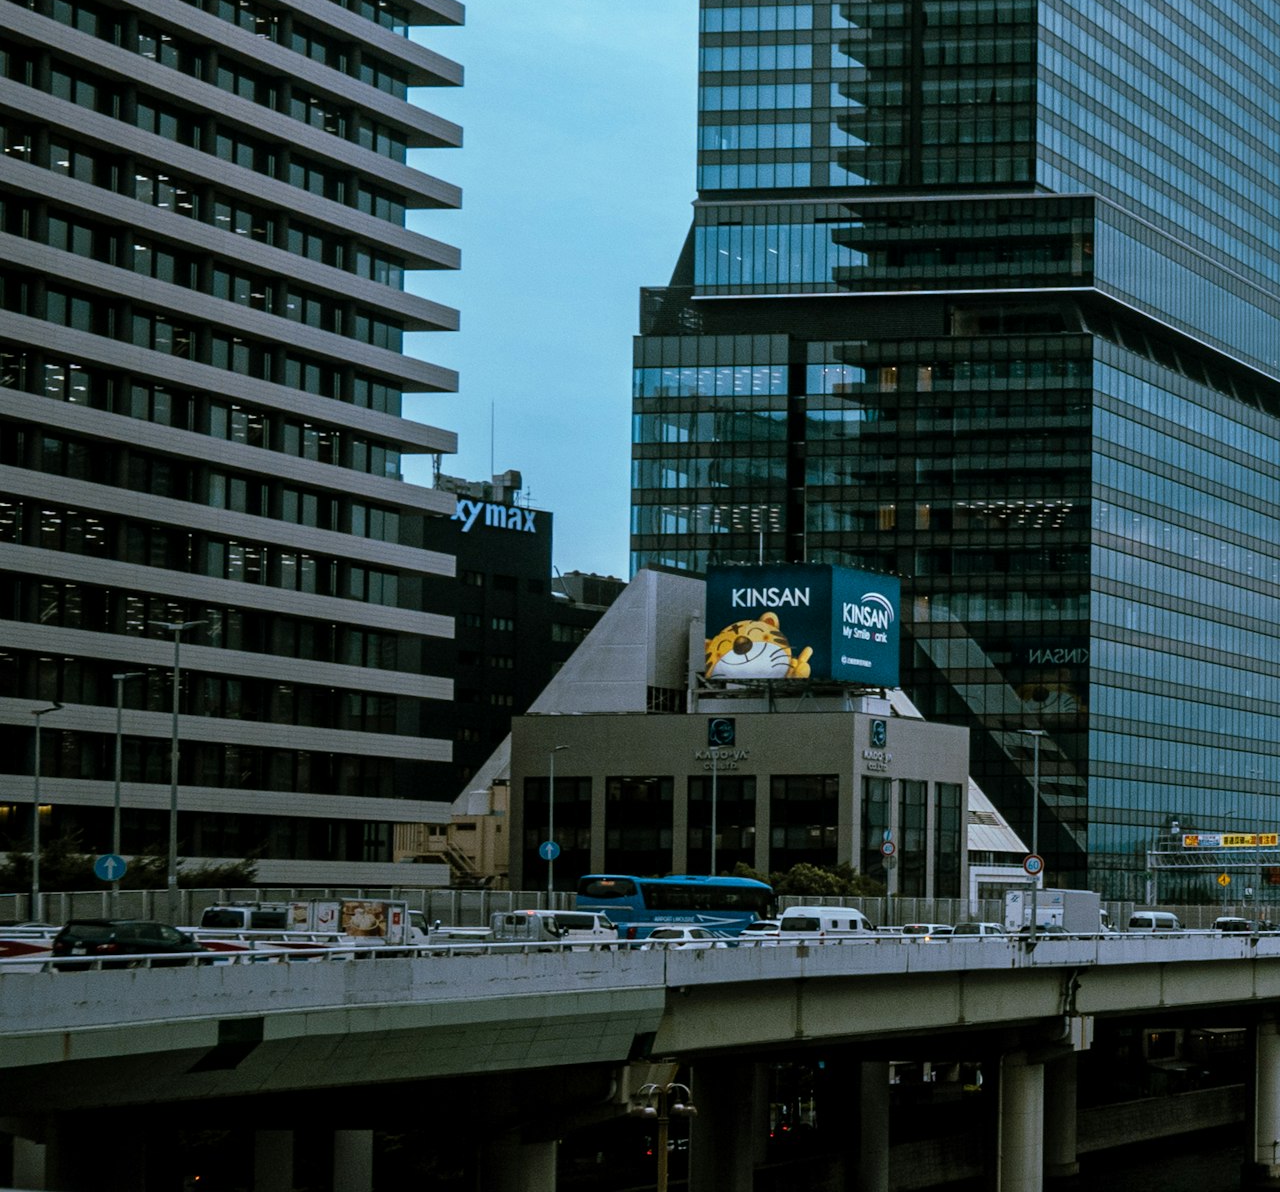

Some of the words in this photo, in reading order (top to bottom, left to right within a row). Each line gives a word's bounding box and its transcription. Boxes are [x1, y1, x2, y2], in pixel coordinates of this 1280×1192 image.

[732, 587, 811, 608] KINSAN
[843, 602, 888, 630] KINSAN
[843, 625, 853, 639] My
[854, 627, 871, 641] Smile
[1028, 860, 1039, 870] 60
